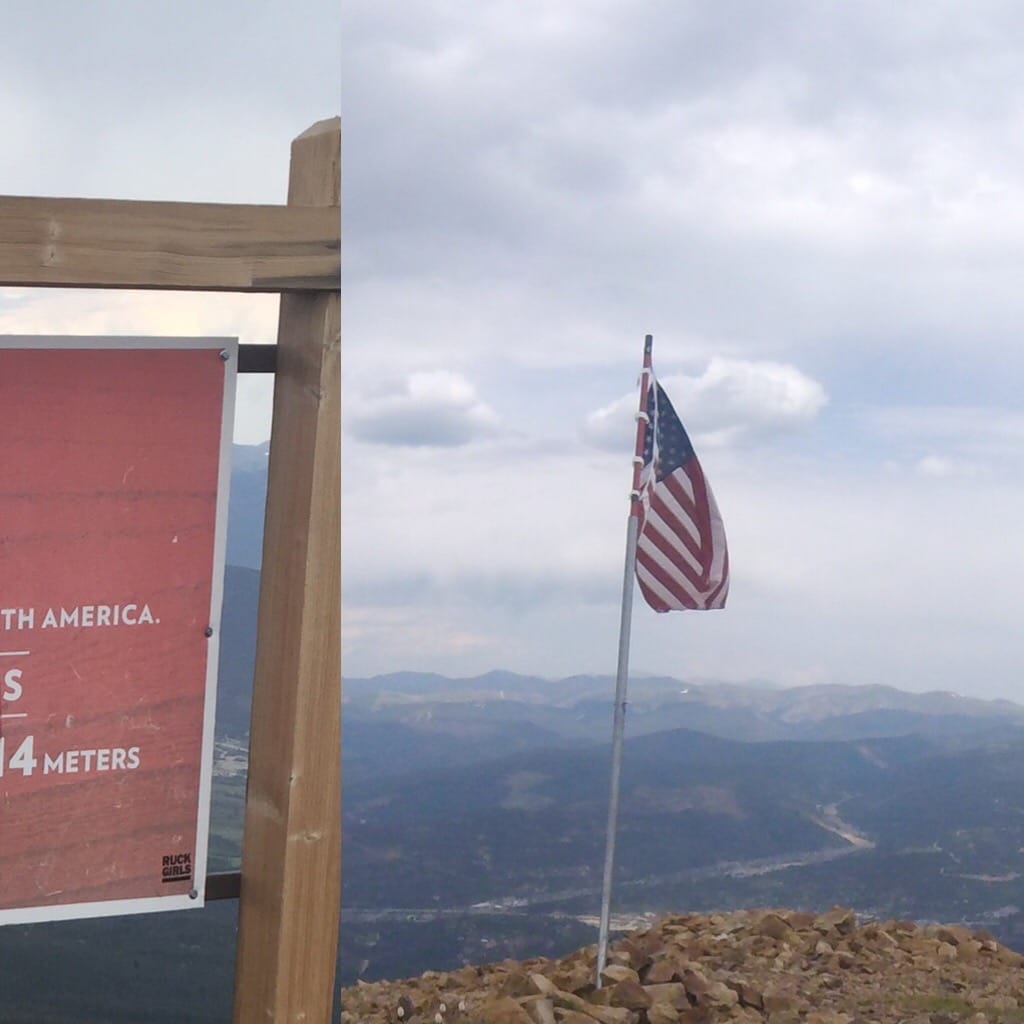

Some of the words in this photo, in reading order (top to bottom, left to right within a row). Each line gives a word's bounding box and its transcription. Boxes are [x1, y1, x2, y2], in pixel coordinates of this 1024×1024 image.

[41, 604, 160, 629] AMERICA.
[43, 746, 140, 775] METERS
[162, 853, 191, 866] RUCK
[162, 864, 192, 877] GIRLS
